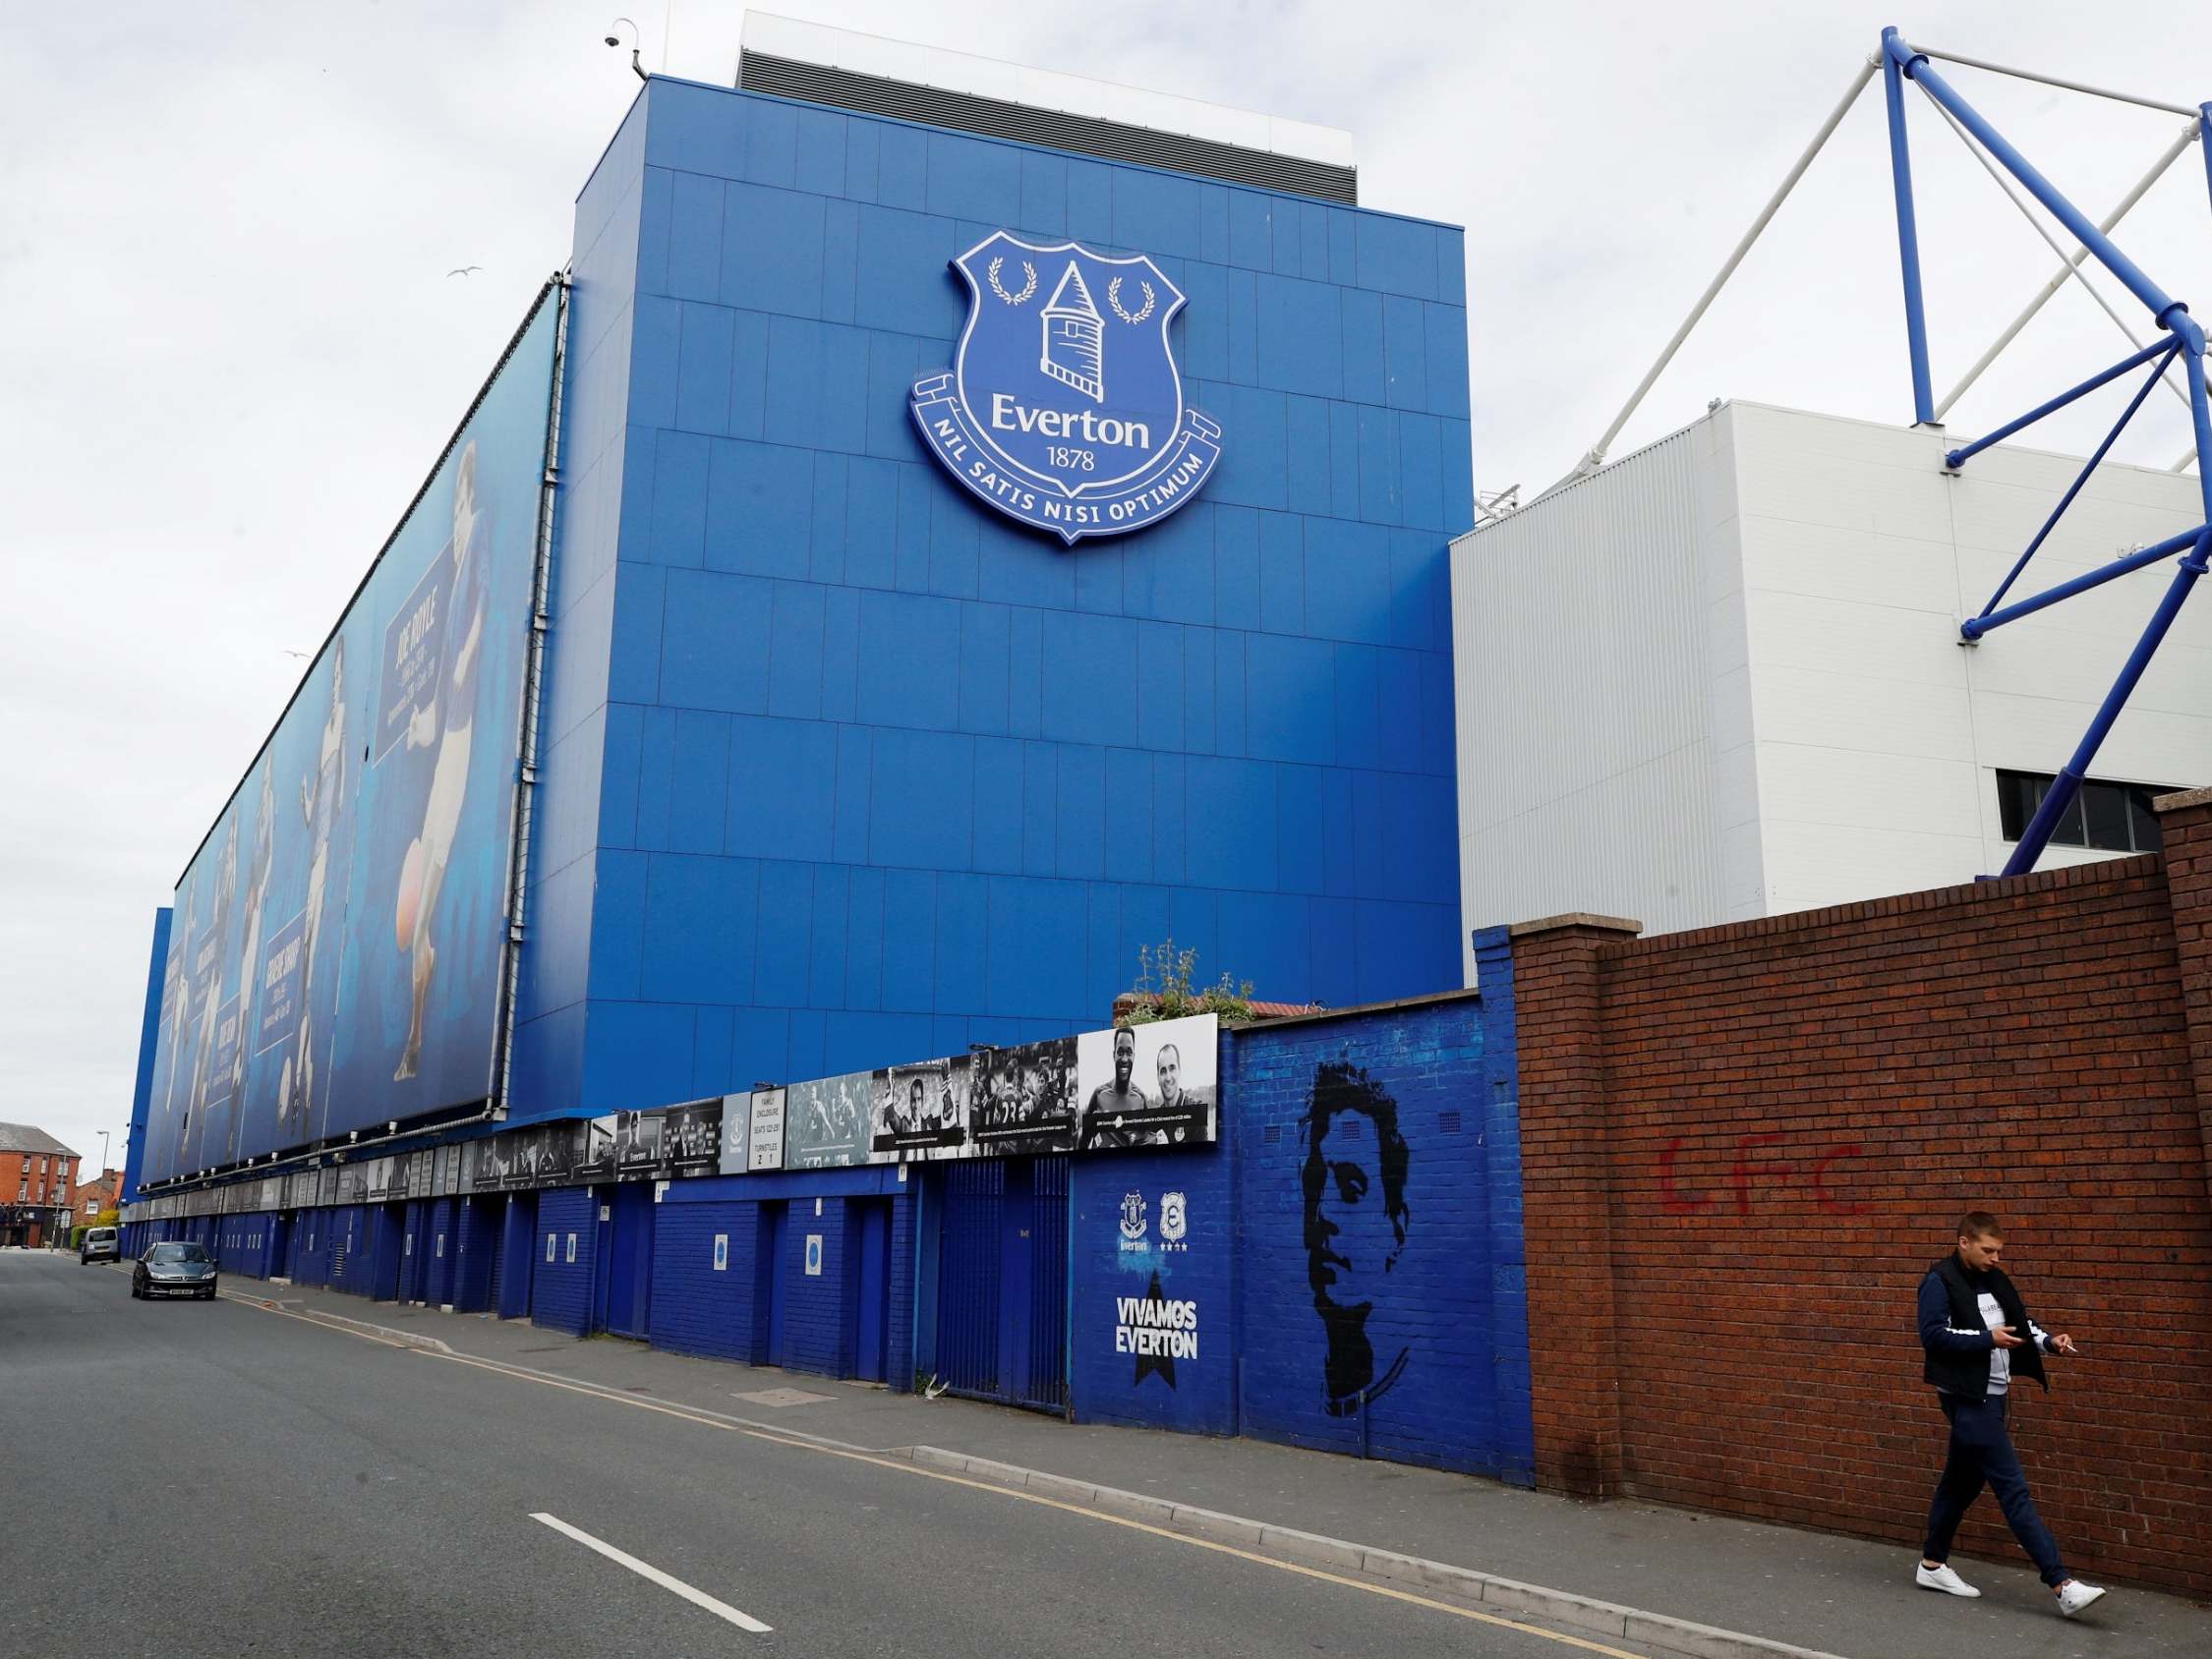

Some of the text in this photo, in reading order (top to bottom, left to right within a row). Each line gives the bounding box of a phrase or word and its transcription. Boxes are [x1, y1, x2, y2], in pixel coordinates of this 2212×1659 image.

[991, 392, 1149, 449] Everton
[934, 419, 1203, 523] NIL SATIS NISI OPTIMUM
[1046, 446, 1095, 472] 1878
[1659, 1134, 1875, 1215] LFC
[1116, 1296, 1197, 1330] VIVAMOS
[1116, 1325, 1198, 1360] EVERTON
